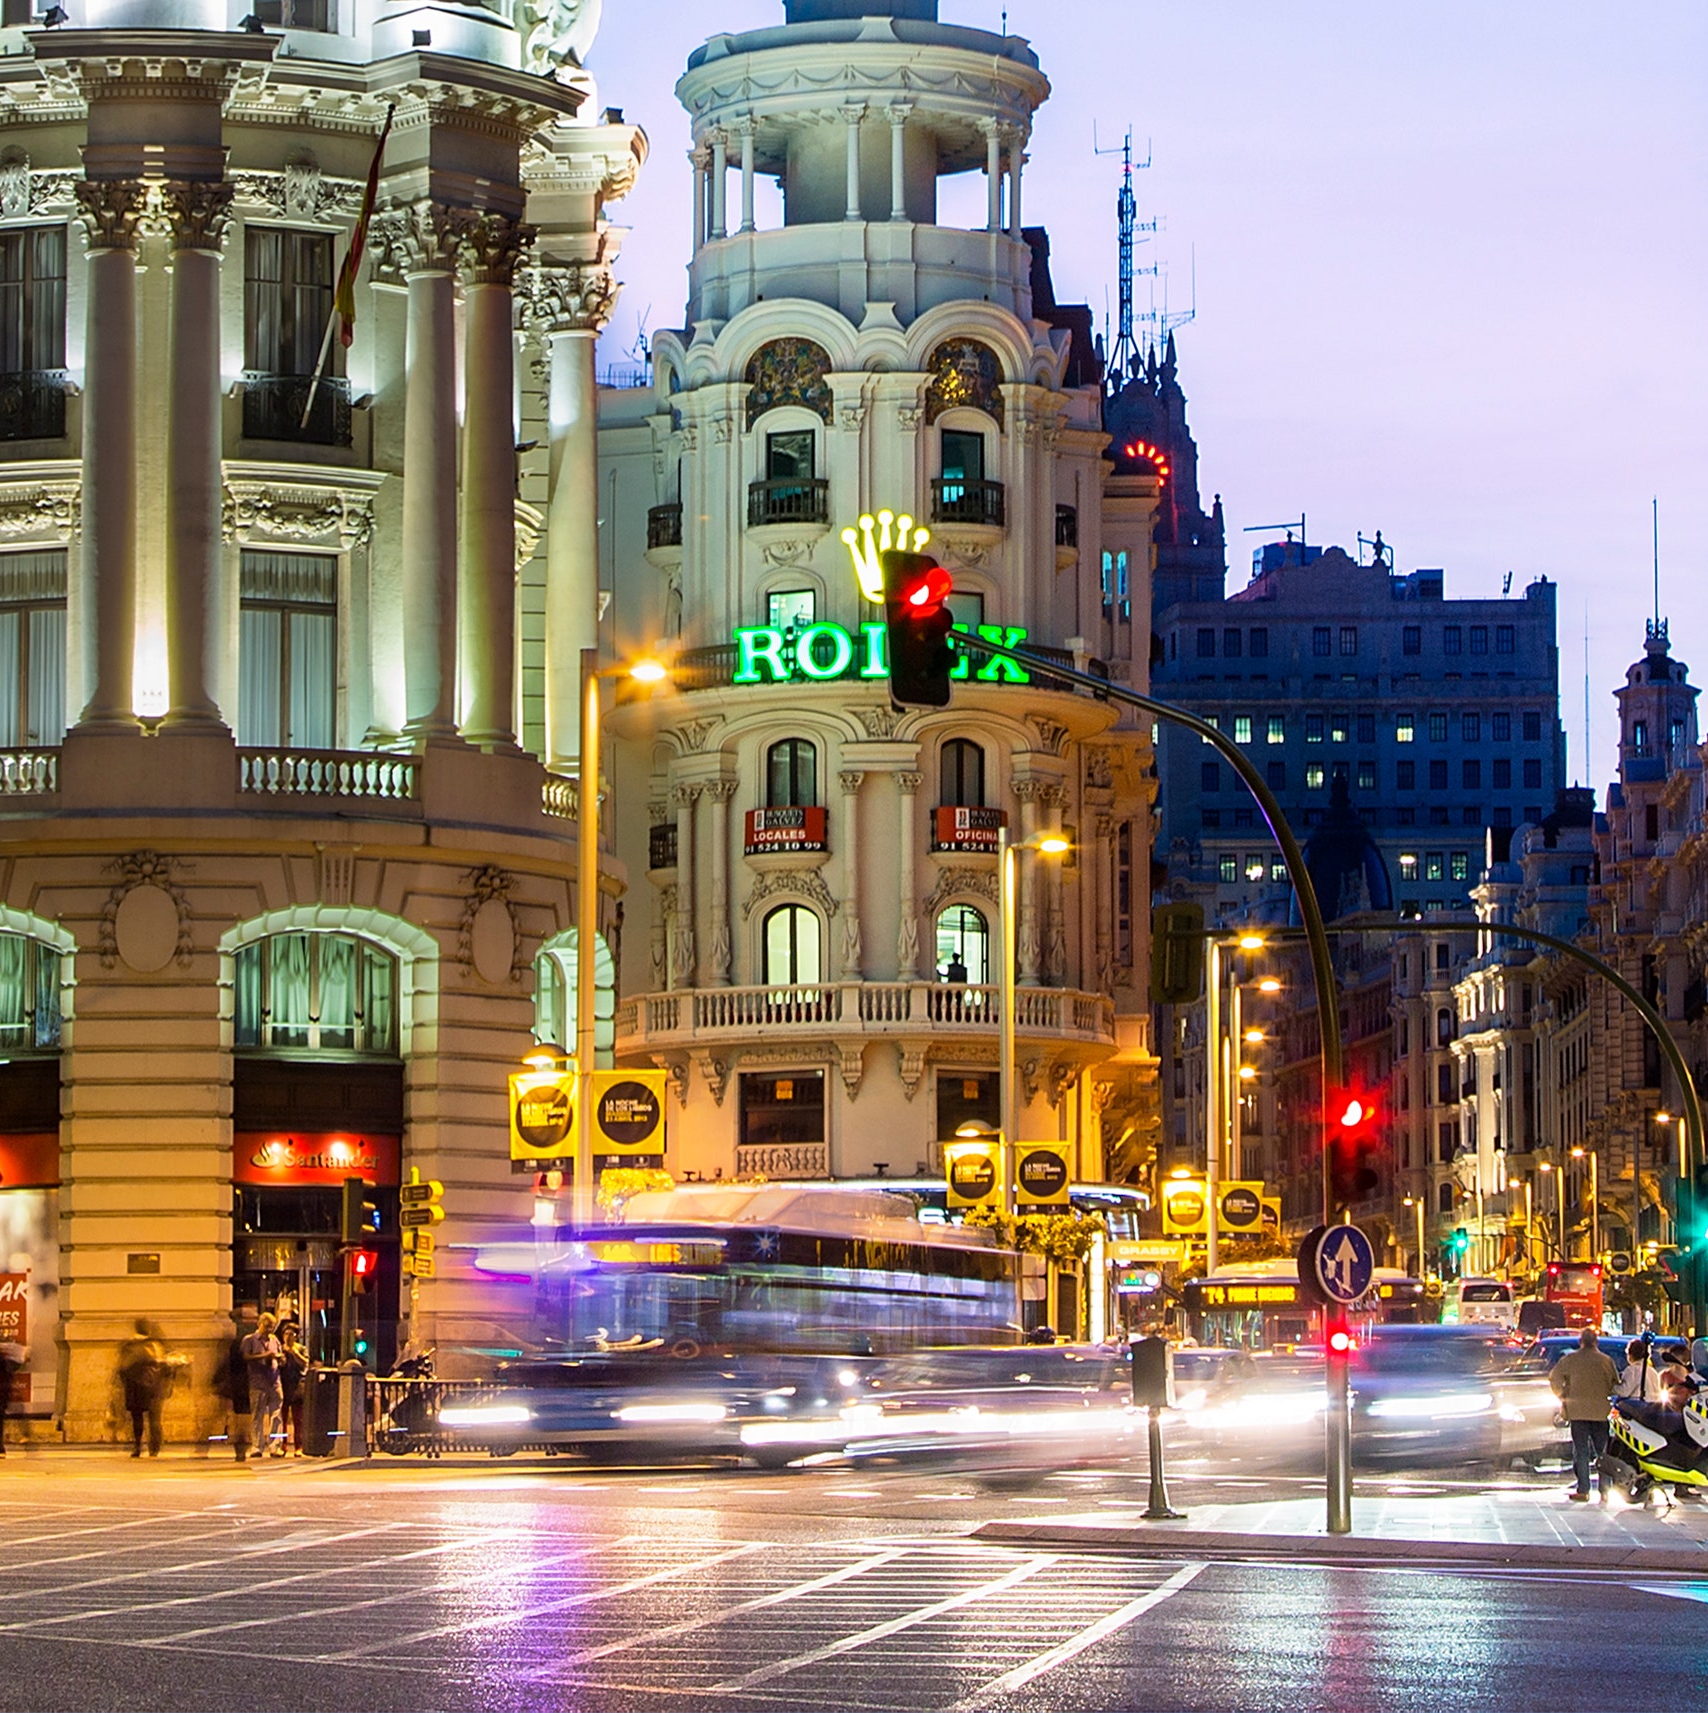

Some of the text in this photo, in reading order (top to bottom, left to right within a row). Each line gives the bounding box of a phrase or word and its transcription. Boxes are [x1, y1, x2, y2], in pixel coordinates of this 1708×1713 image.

[753, 829, 806, 843] LOCALES
[955, 830, 998, 840] OFICINA
[757, 842, 779, 853] 524
[784, 842, 800, 851] 10
[804, 841, 822, 851] 99
[940, 842, 956, 851] 91
[962, 842, 985, 852] 524
[284, 1146, 381, 1170] Santander
[1118, 1246, 1178, 1255] GRASSY
[1207, 1286, 1225, 1304] 74
